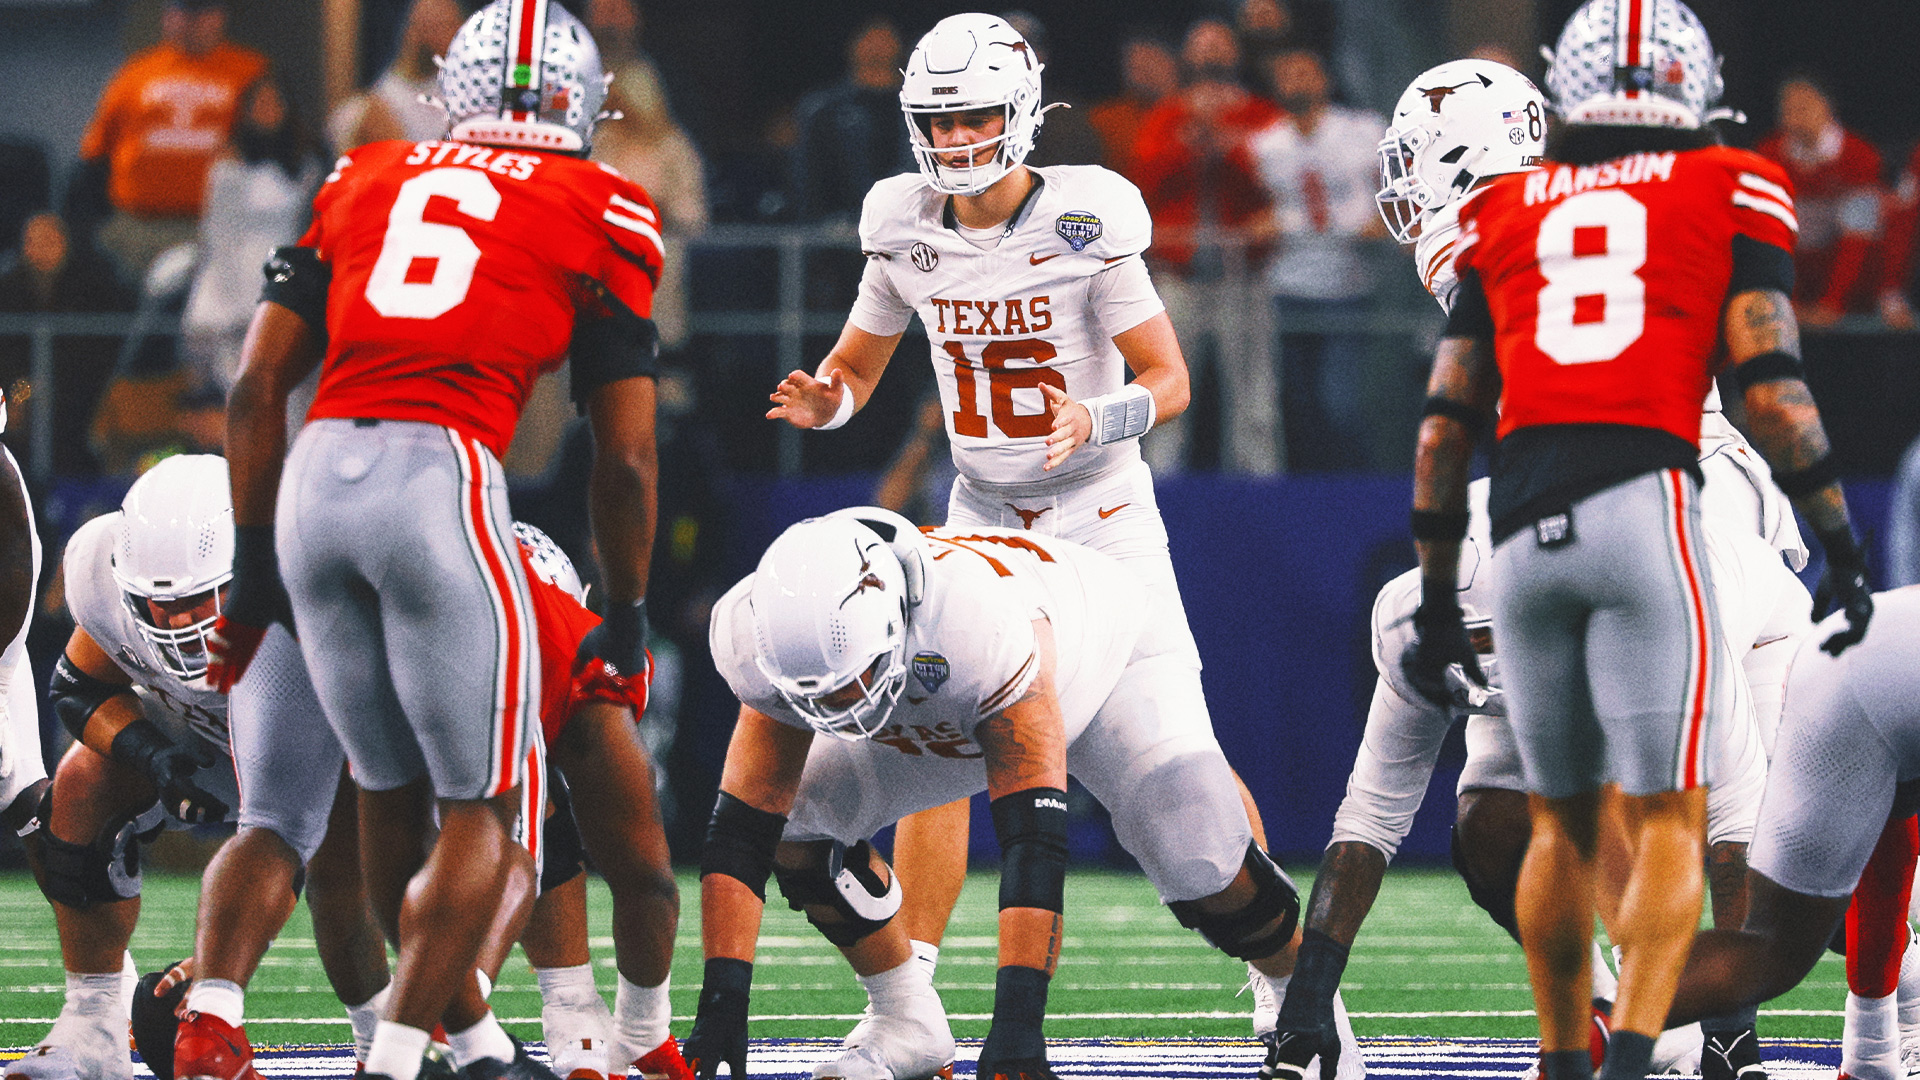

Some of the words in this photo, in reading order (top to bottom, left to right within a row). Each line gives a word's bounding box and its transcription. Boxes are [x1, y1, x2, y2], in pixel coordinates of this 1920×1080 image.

[1509, 127, 1525, 146] SEC
[1524, 100, 1542, 142] 8
[405, 140, 542, 181] STYLES
[1523, 151, 1677, 207] RANSOM
[364, 167, 502, 320] 6
[1059, 221, 1100, 236] COTTON
[1065, 230, 1092, 238] BOWL
[911, 242, 938, 272] SEC
[1534, 188, 1648, 367] 8
[931, 296, 1053, 335] TEXAS
[942, 338, 1067, 438] 16
